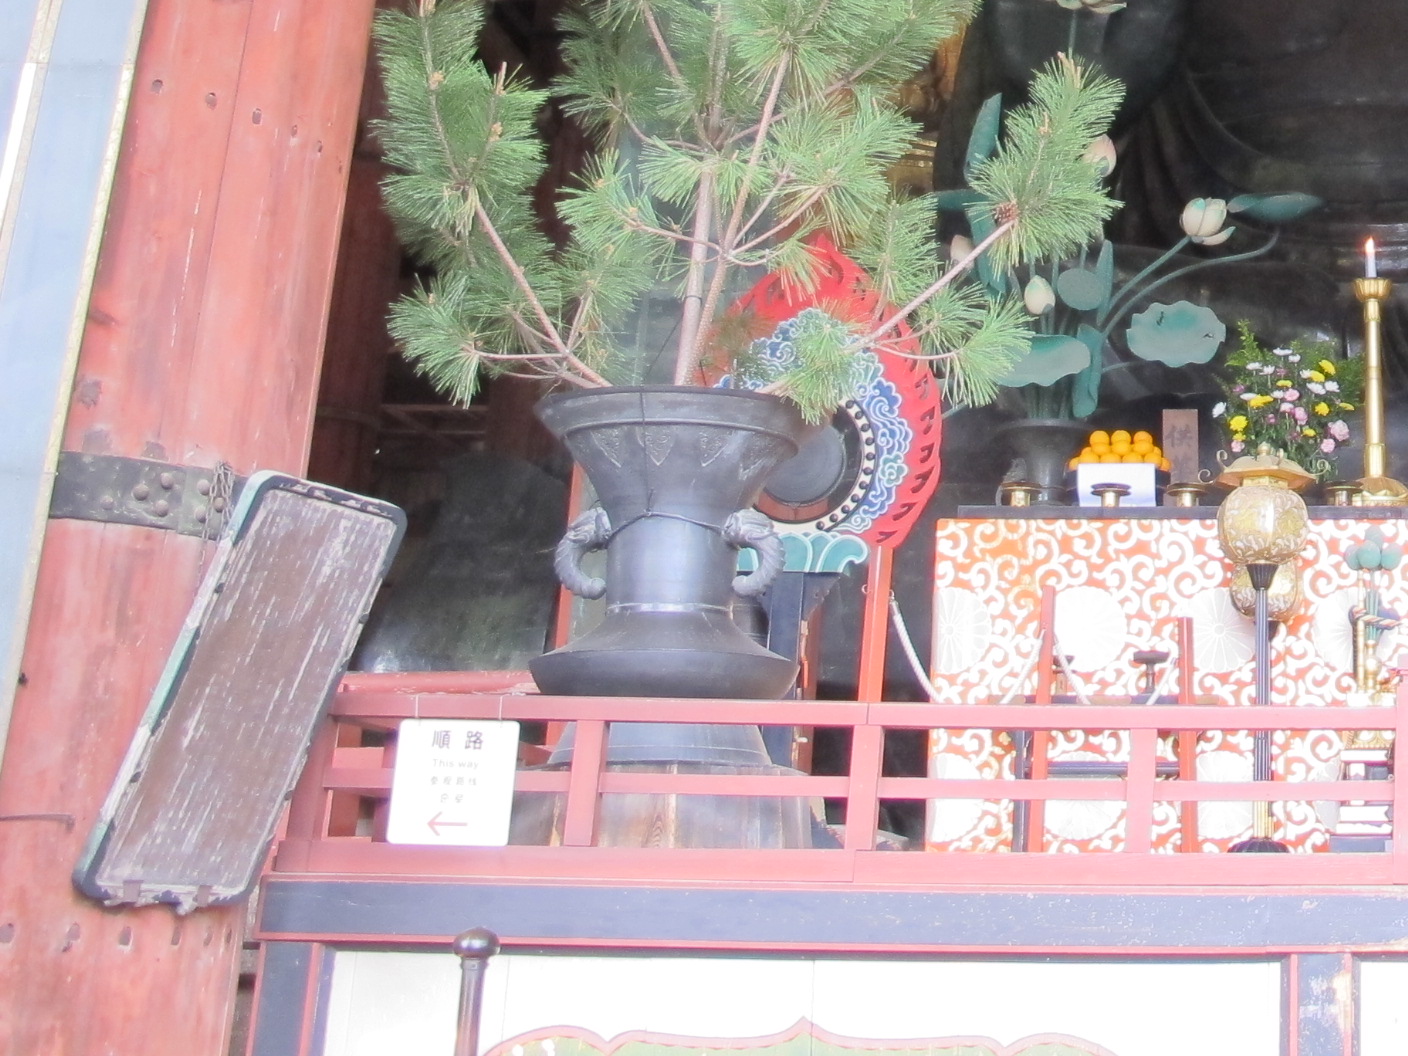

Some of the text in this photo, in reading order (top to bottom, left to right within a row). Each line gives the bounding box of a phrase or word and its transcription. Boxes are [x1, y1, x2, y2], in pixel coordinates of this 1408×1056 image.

[431, 730, 484, 750] 順路
[433, 758, 479, 770] This way
